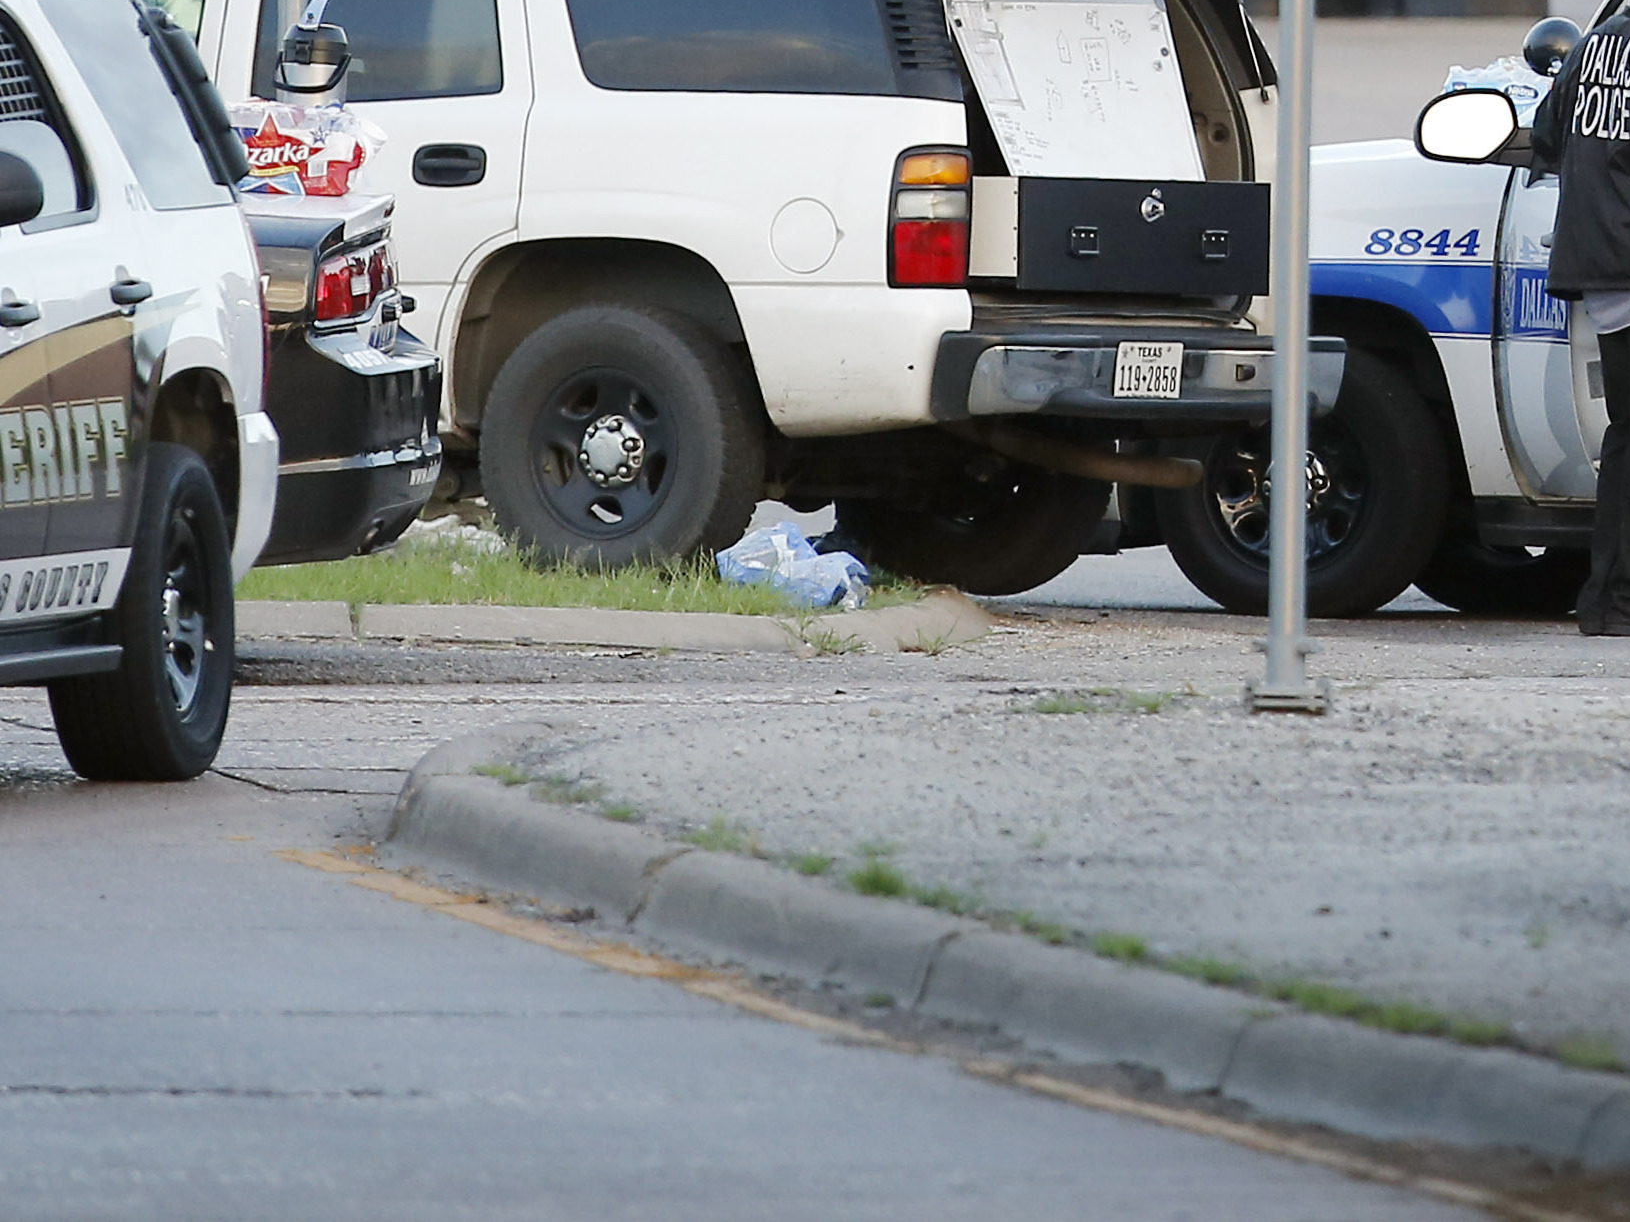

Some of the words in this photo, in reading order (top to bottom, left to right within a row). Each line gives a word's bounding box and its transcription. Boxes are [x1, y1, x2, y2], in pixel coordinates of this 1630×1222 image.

[1363, 228, 1481, 257] 8844
[1138, 346, 1163, 358] TEXAS
[16, 561, 108, 613] COUNTY
